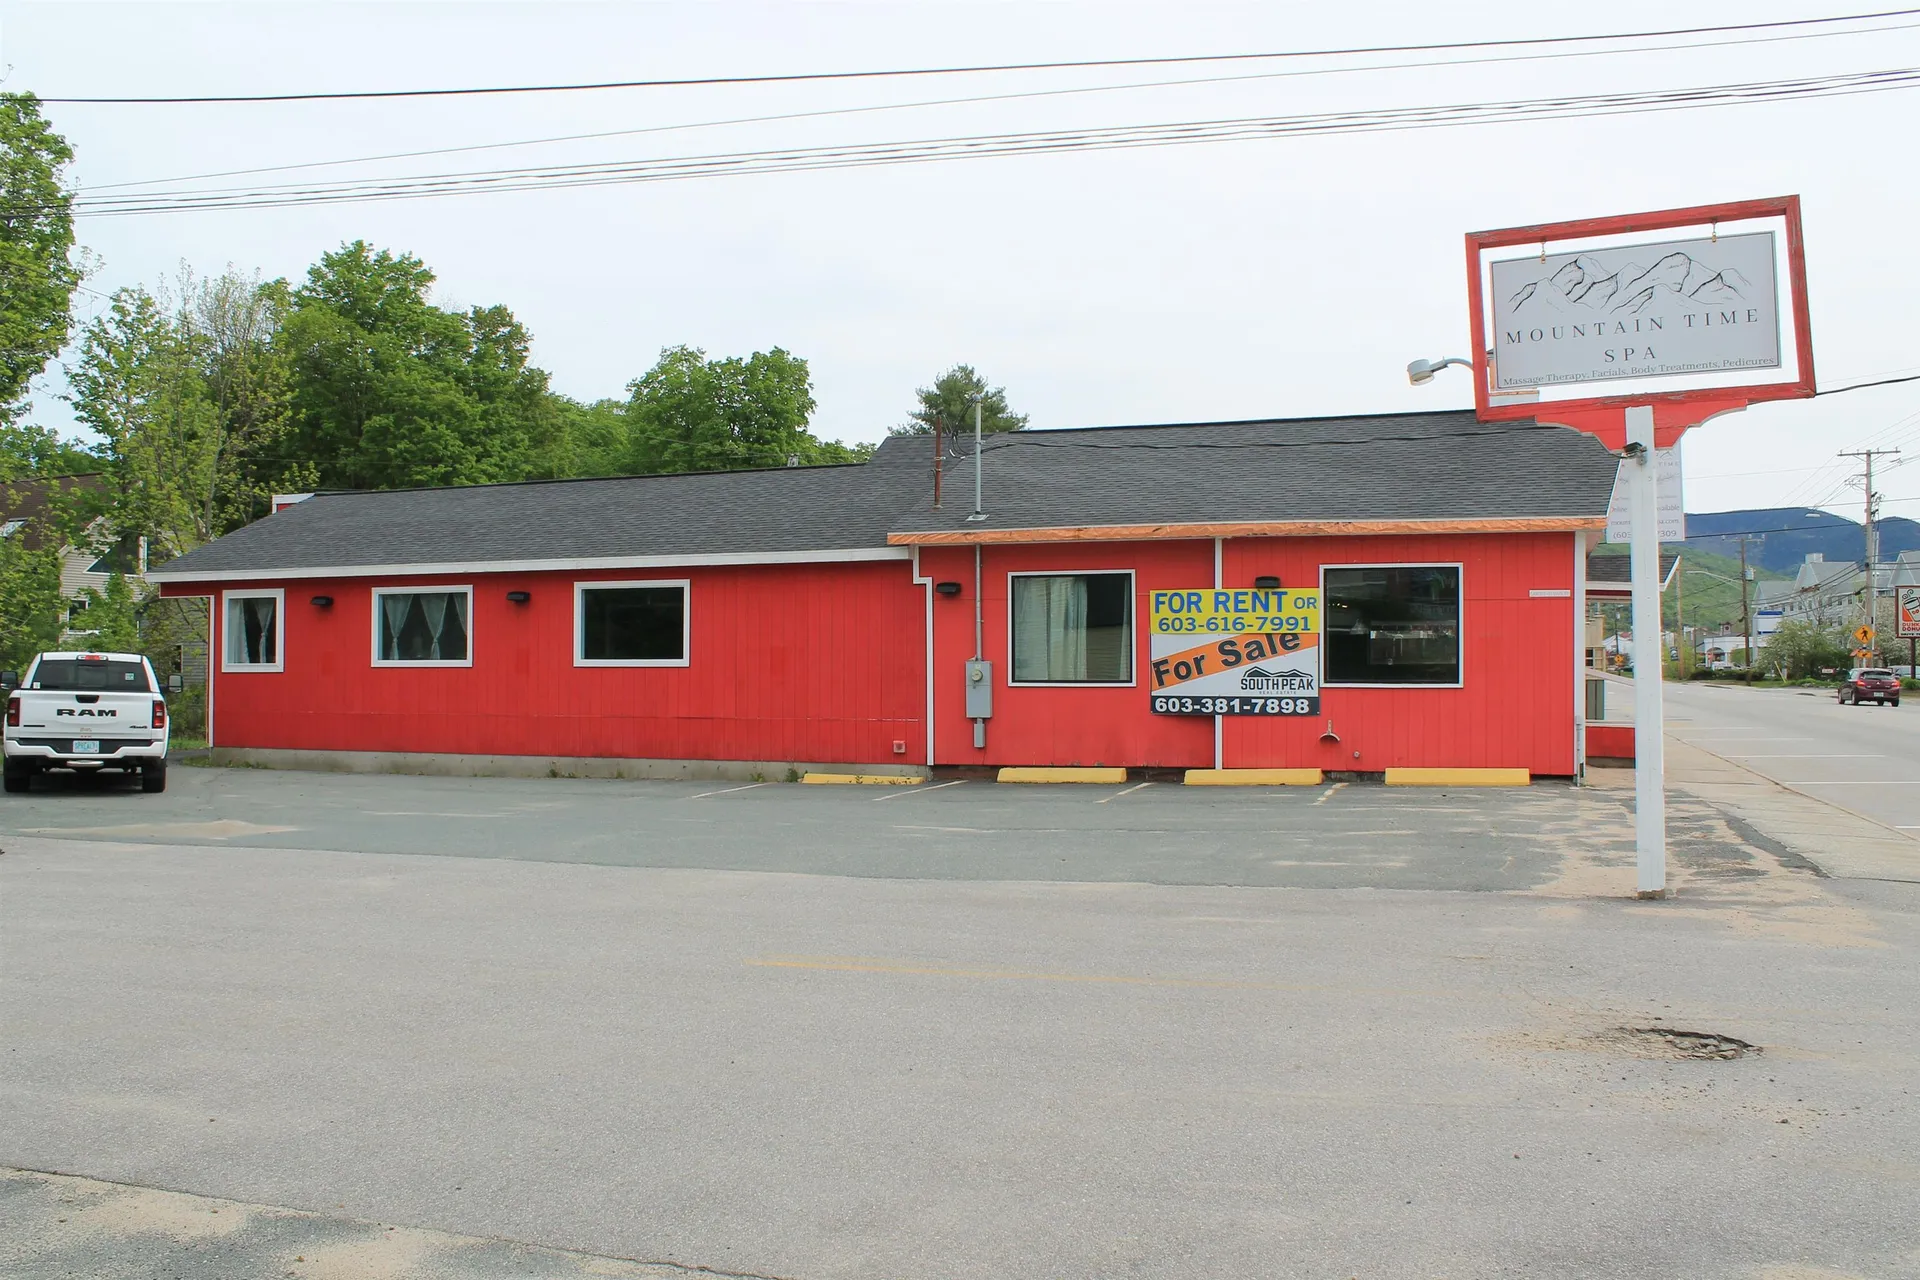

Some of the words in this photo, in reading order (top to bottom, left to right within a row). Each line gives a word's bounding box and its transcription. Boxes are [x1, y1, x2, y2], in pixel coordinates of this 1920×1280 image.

[1506, 316, 1664, 345] MOUNTAIN
[1683, 308, 1758, 328] TIME
[1604, 346, 1656, 363] SPA
[1503, 376, 1544, 386] Massage
[1631, 366, 1656, 375] Body
[1722, 357, 1774, 367] Pedicures
[1154, 592, 1202, 614] FOR
[1213, 591, 1288, 613] RENT
[1293, 597, 1317, 609] OR
[1158, 616, 1311, 632] 603-616-7991
[1152, 653, 1205, 687] For
[1217, 633, 1301, 667] Sale
[56, 708, 117, 717] RAM
[1155, 698, 1309, 714] 603-381-7898
